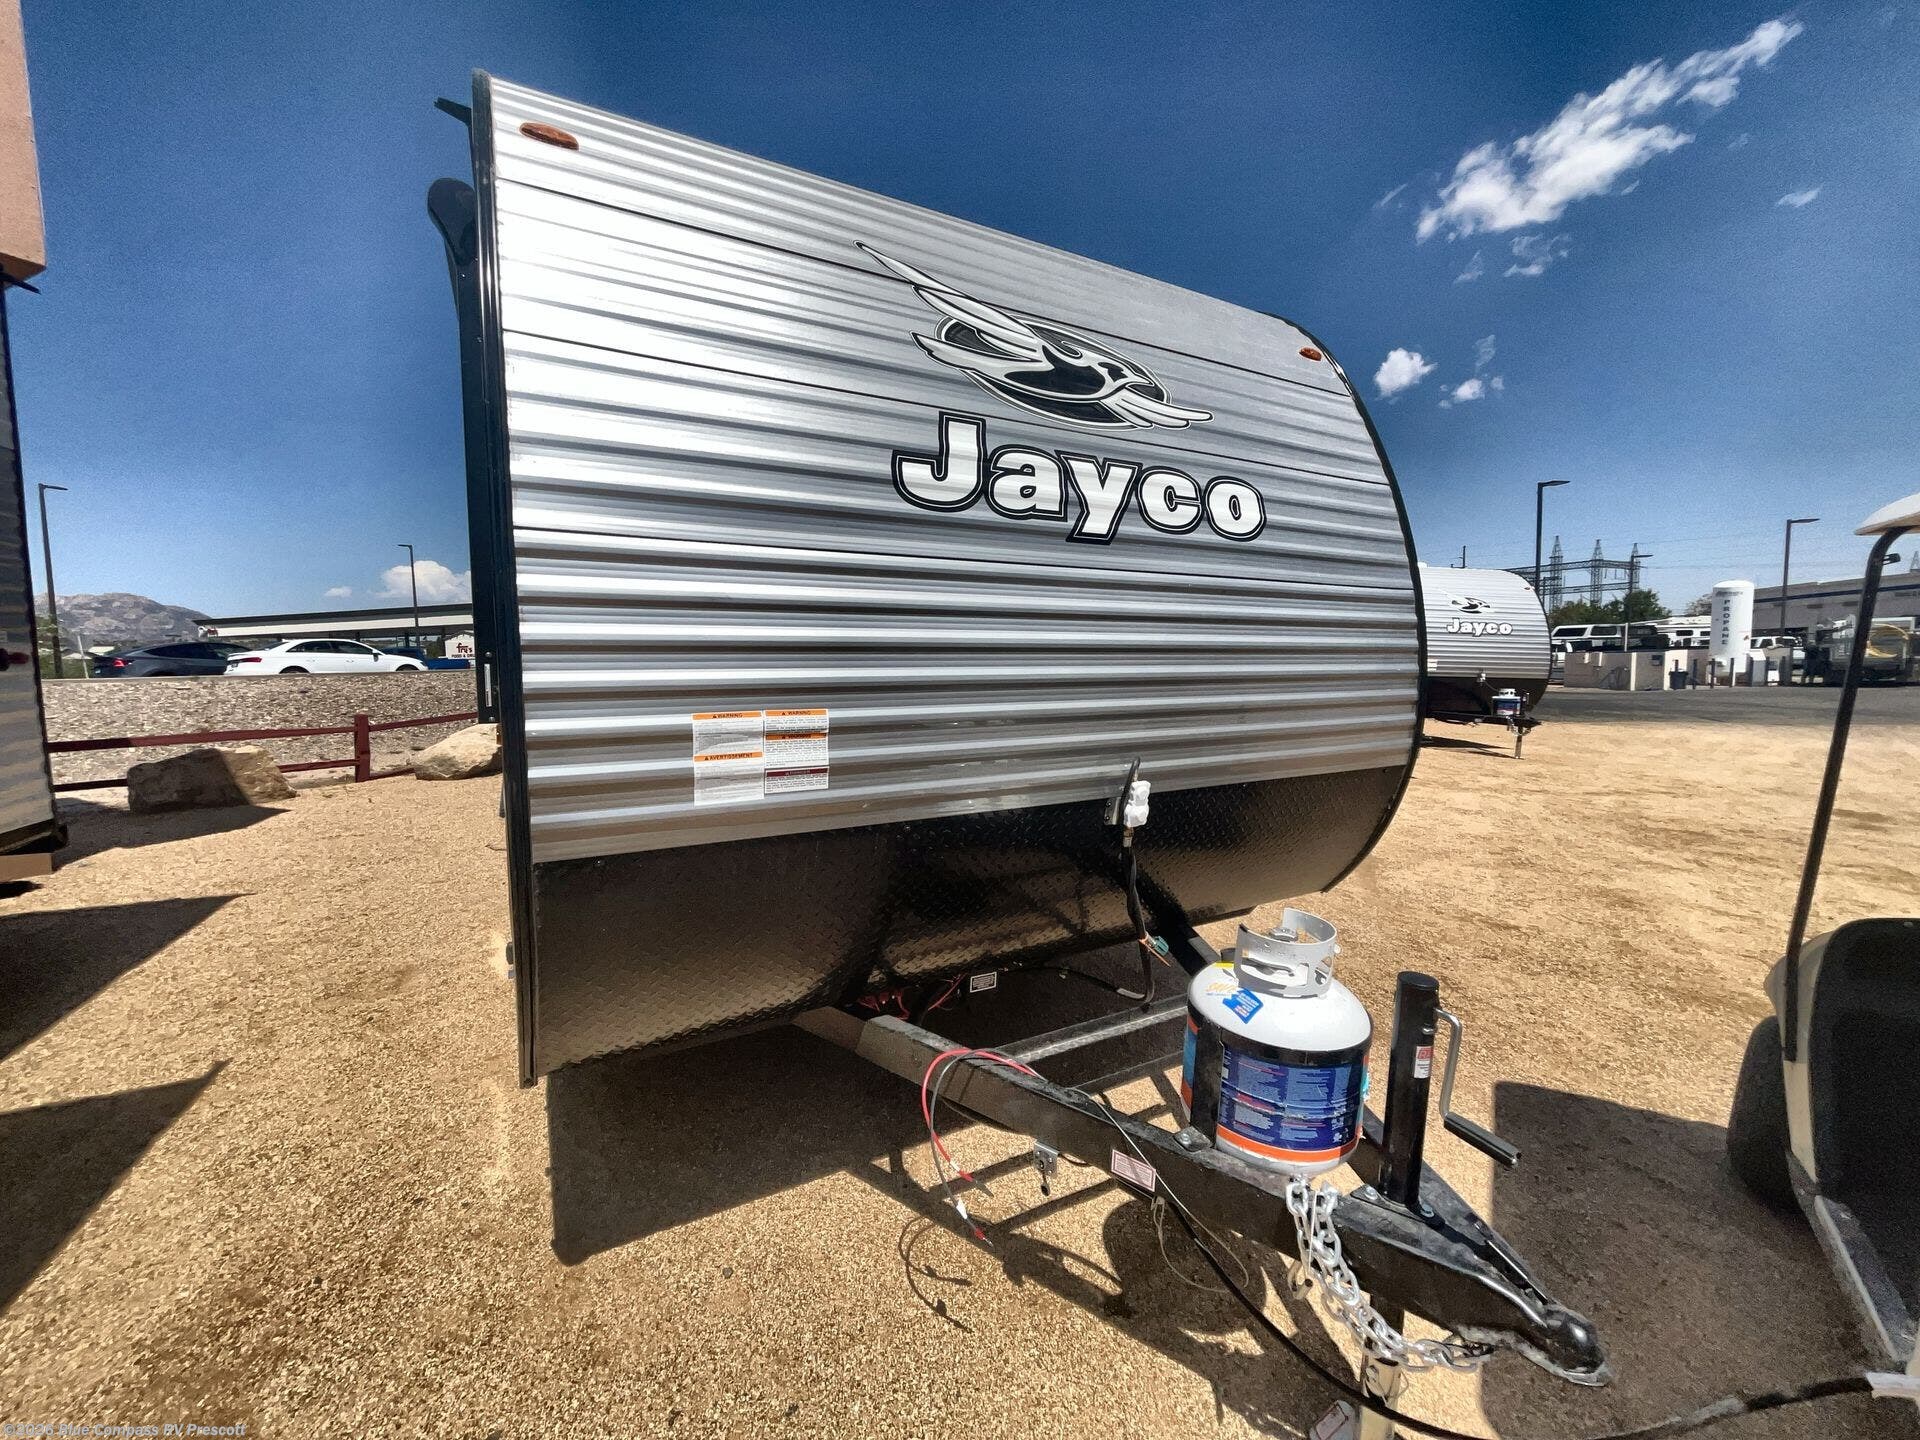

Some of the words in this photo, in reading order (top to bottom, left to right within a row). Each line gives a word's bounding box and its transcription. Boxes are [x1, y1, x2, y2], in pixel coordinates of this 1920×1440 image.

[891, 411, 1267, 545] Jayco
[1446, 617, 1513, 637] Jayco
[1721, 599, 1730, 645] PROPANE
